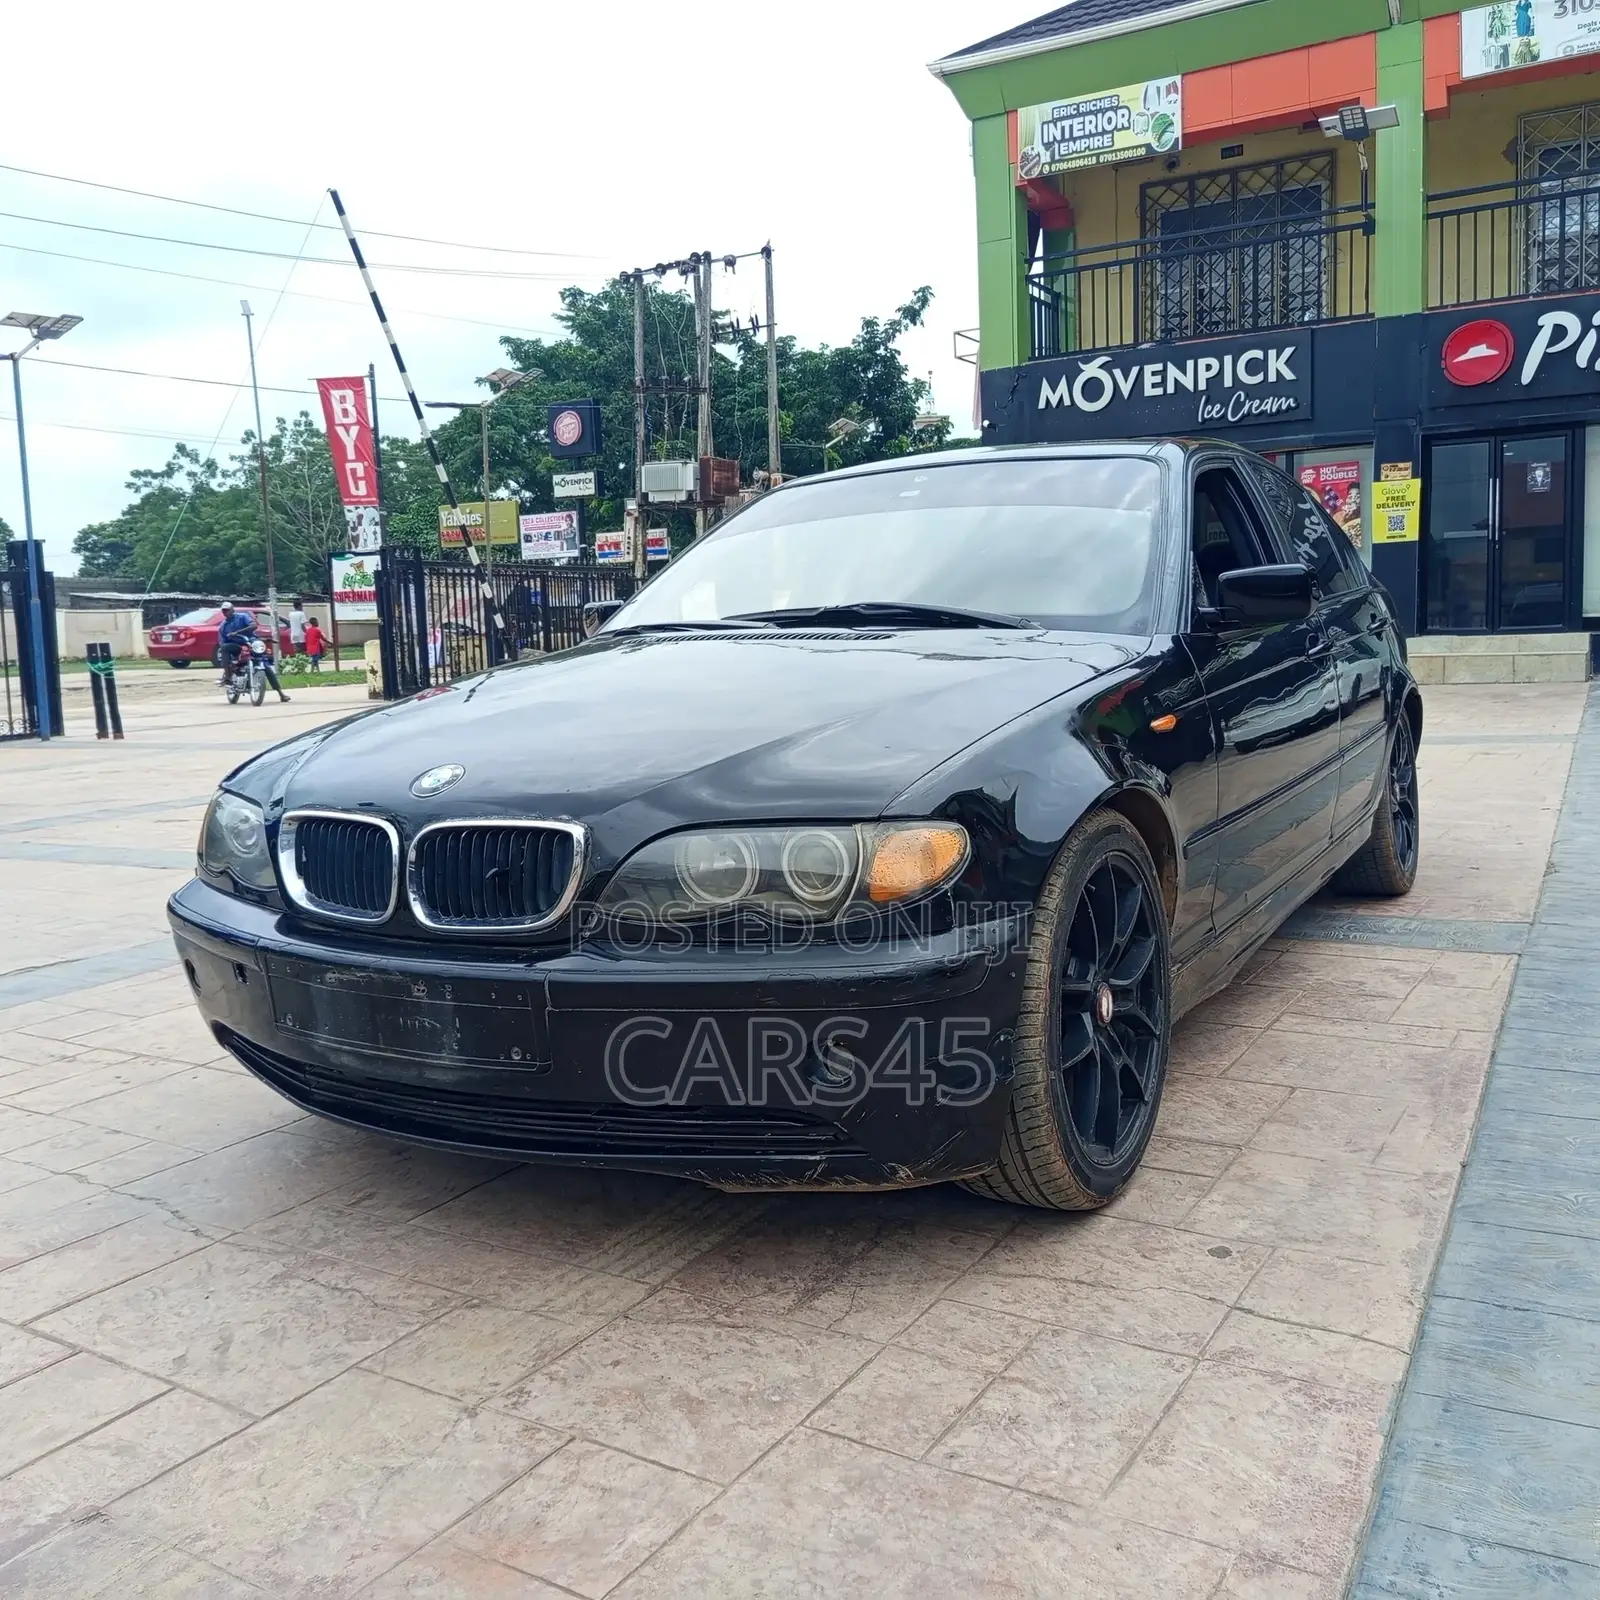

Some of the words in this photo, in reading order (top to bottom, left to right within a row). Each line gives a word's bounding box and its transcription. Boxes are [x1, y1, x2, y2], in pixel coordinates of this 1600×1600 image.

[1053, 104, 1078, 119] ERIC
[1079, 95, 1120, 114] RICHES
[1042, 108, 1130, 144] INTERIOR
[1060, 134, 1113, 155] EMPIRE
[1197, 394, 1225, 423] Ice
[1227, 391, 1297, 423] Cream
[1320, 466, 1337, 475] HUT
[1320, 470, 1358, 481] DOUBLES
[1381, 485, 1407, 496] Glovo
[1376, 500, 1416, 510] DELIVERY
